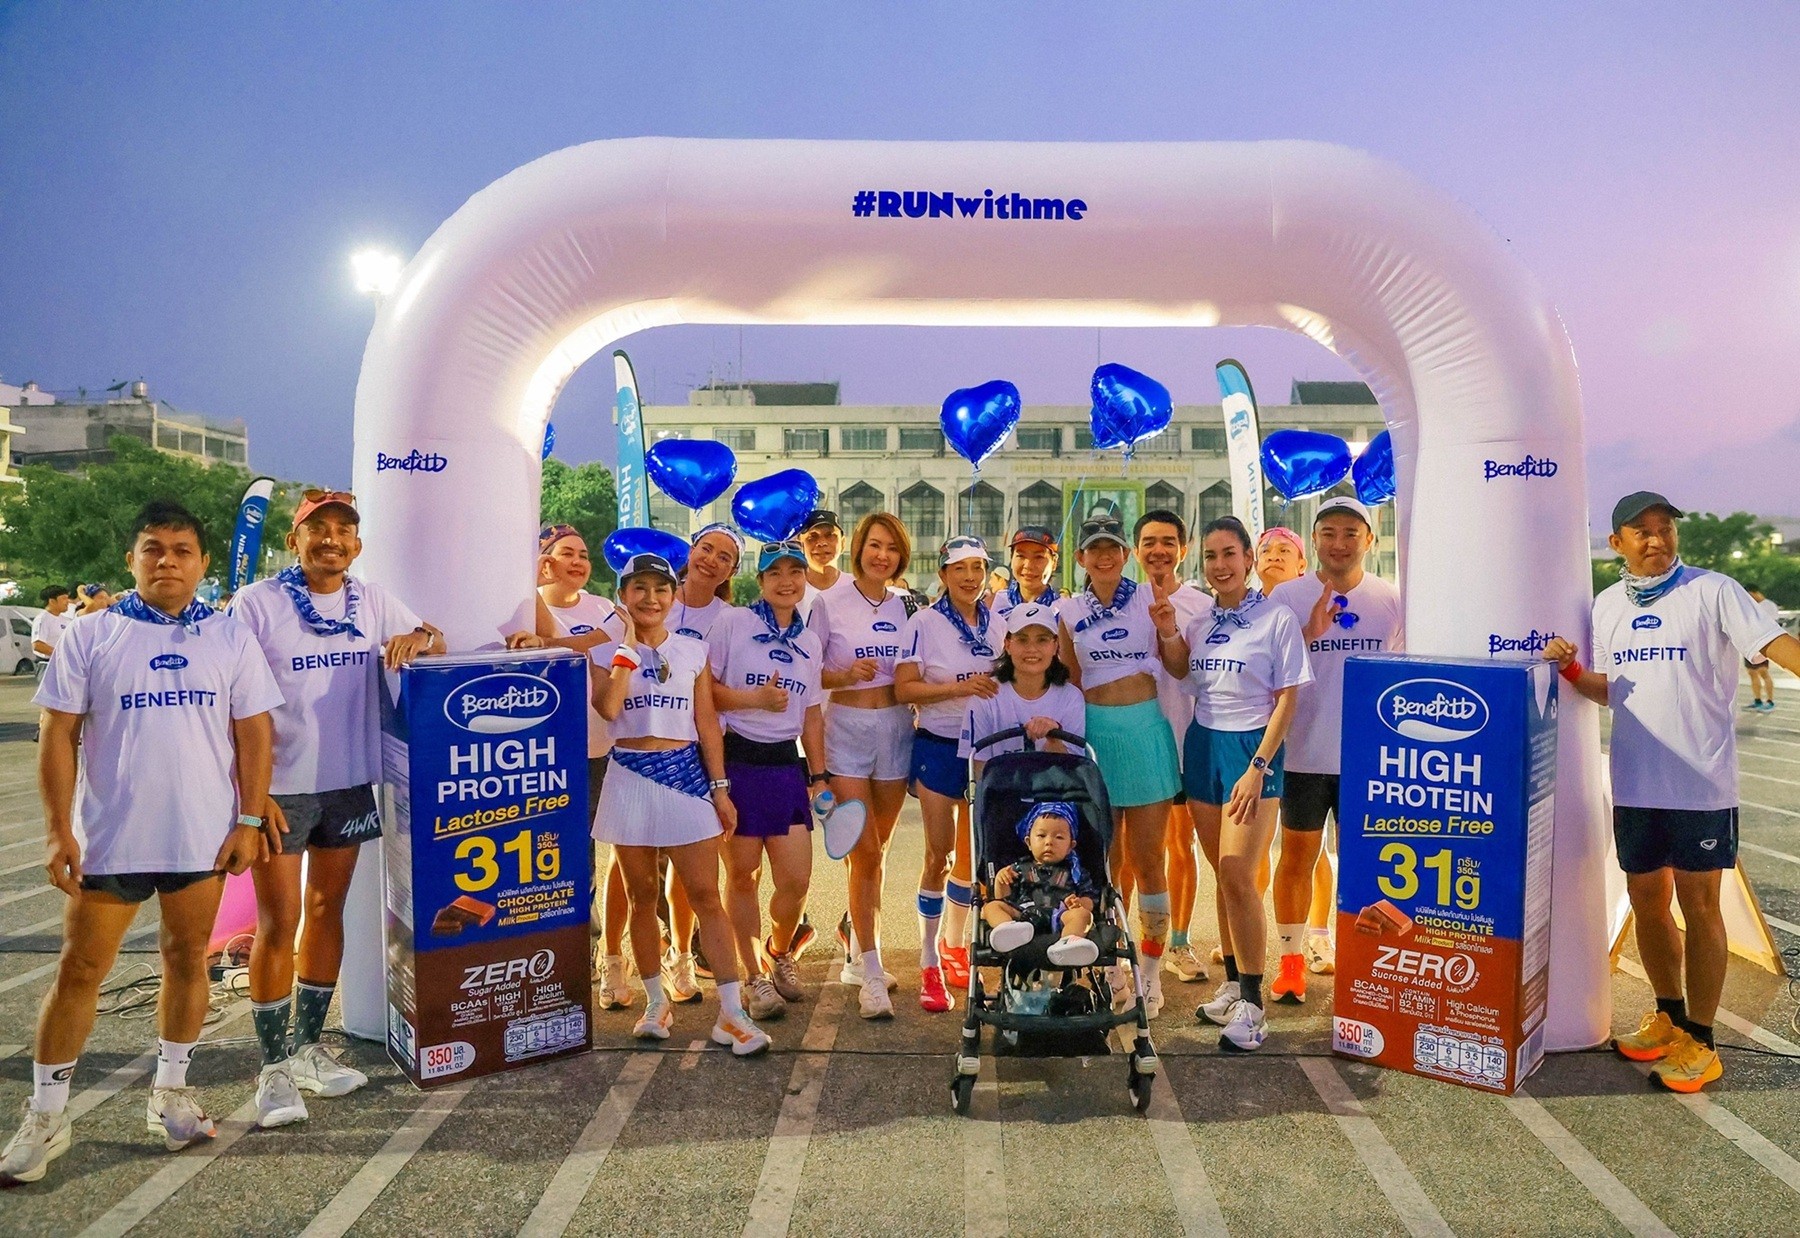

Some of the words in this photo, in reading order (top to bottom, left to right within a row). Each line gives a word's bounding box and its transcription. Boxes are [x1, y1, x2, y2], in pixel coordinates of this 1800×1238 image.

[852, 189, 1088, 220] #RUNwithme
[1310, 639, 1382, 652] BENEFITT
[1191, 658, 1246, 673] ENEFITT
[121, 690, 216, 710] BENEFITT
[450, 737, 555, 775] HIGH
[1379, 745, 1482, 786] HIGH
[438, 769, 567, 803] PROTEIN
[1367, 780, 1493, 815] PROTEIN
[434, 805, 519, 833] Lactose
[525, 794, 569, 815] Free
[1363, 814, 1442, 833] Lactose
[1447, 816, 1494, 835] Free
[497, 889, 575, 908] CHOCOLATE
[509, 905, 531, 915] HIGH
[532, 899, 568, 911] PROTEIN
[1414, 915, 1494, 936] CHOCOLATE
[1414, 934, 1432, 944] Milk
[1425, 927, 1447, 937] HIGH
[1448, 931, 1486, 943] PROTEIN
[460, 949, 555, 989] ZERO
[1373, 945, 1475, 985] ZERO
[1354, 979, 1389, 994] BCAAs
[1371, 969, 1409, 984] Sucrose
[1411, 977, 1443, 990] Added
[468, 986, 493, 997] Sugar
[494, 980, 521, 992] Added
[494, 991, 521, 1003] HIGH
[532, 990, 565, 1002] Calcium
[536, 982, 562, 995] HIGH
[451, 999, 488, 1011] BCAAs
[1399, 991, 1436, 1005] VITAMIN
[1416, 1002, 1435, 1013] B12
[1446, 999, 1465, 1010] High
[1466, 1002, 1500, 1016] Calcium
[1339, 1021, 1361, 1043] 350
[1419, 1041, 1435, 1051] 230
[1446, 1047, 1452, 1055] 6
[427, 1047, 452, 1067] 350
[1464, 1051, 1478, 1060] 3.5
[1487, 1056, 1502, 1065] 140
